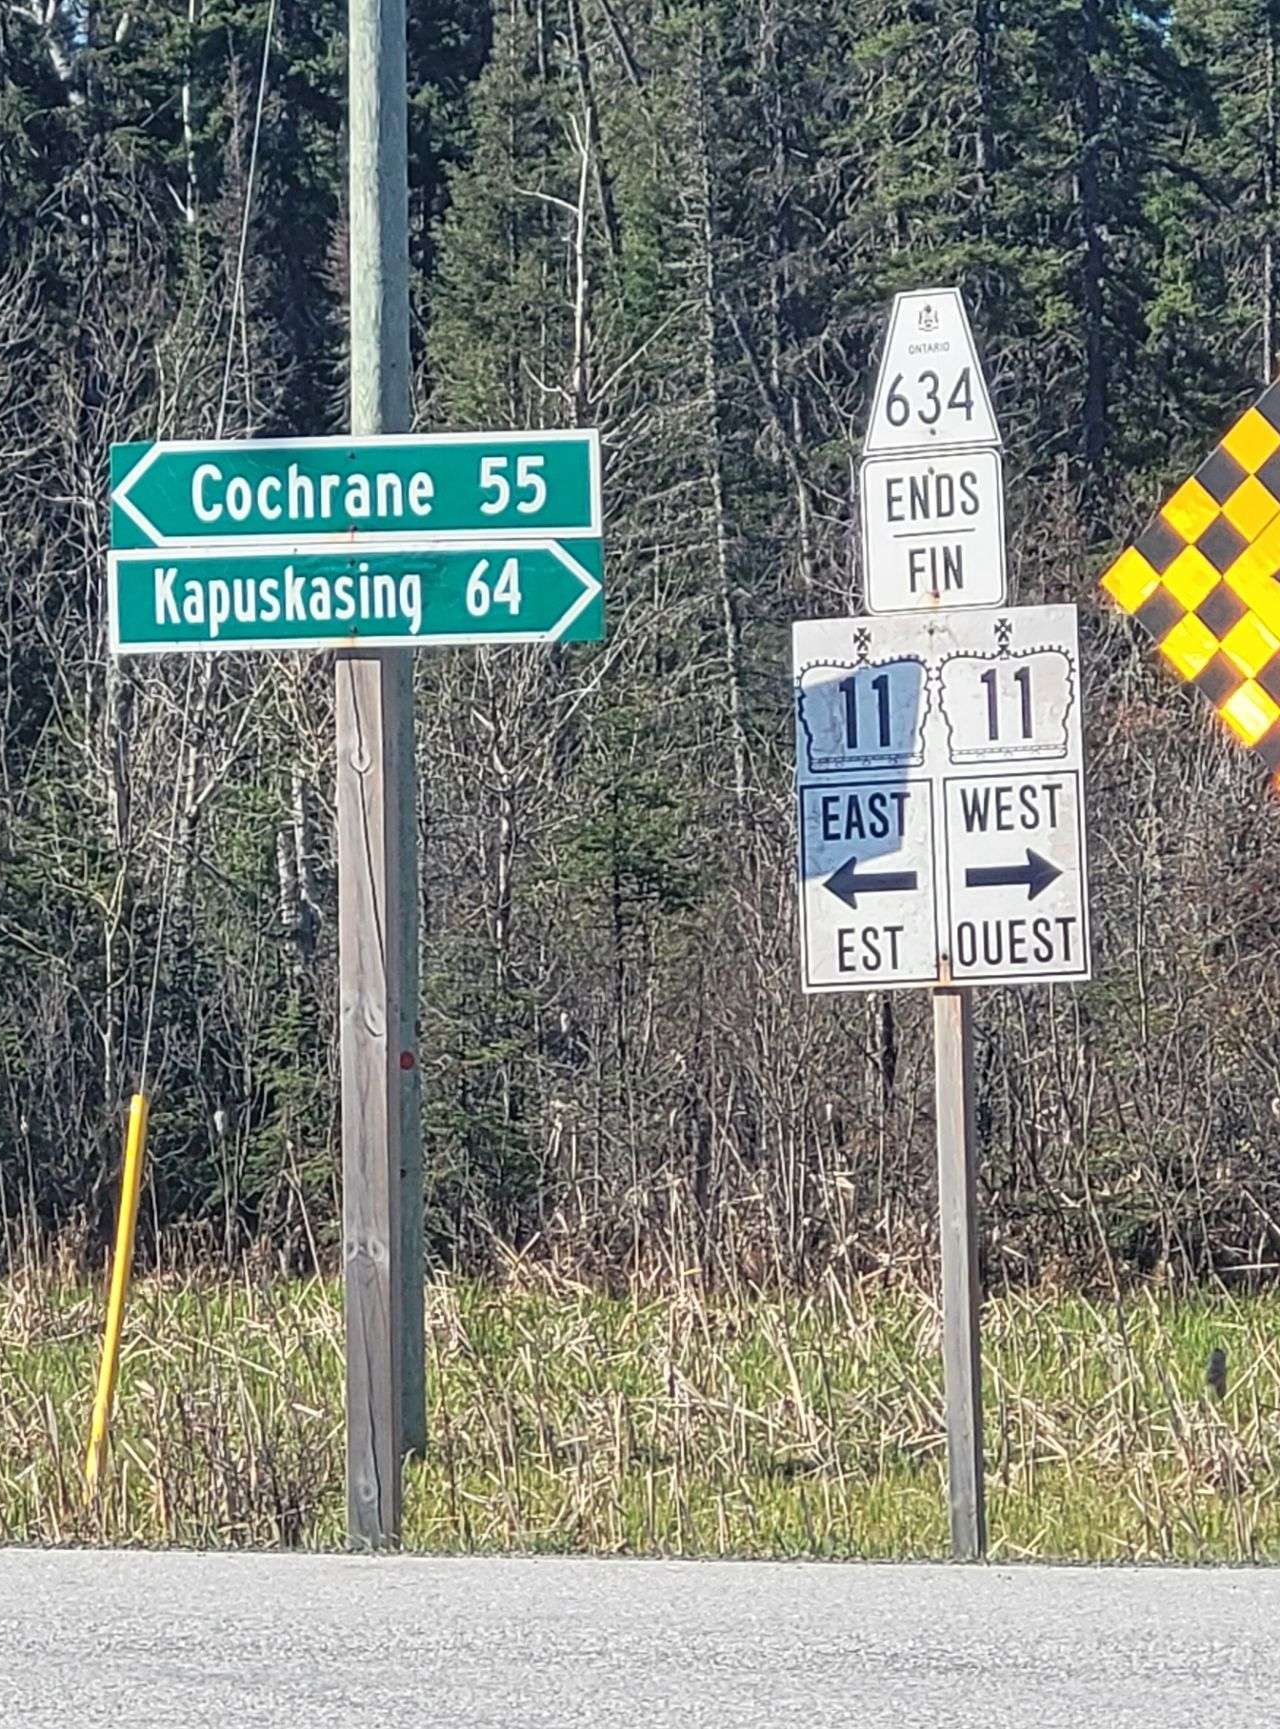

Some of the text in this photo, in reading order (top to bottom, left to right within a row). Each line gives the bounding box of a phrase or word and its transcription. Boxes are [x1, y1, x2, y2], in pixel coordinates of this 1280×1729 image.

[908, 341, 950, 355] ONTARIO
[885, 366, 974, 428] 634
[191, 455, 548, 523] Cochrane 55
[885, 470, 980, 523] ENDS
[908, 544, 964, 593] FIN
[153, 557, 522, 638] Kapuskasing 64
[838, 673, 890, 749] 11
[980, 665, 1033, 741] 11
[821, 791, 911, 842] EAST
[960, 783, 1063, 833] WEST
[837, 924, 904, 973] EST
[956, 916, 1077, 968] OUEST
